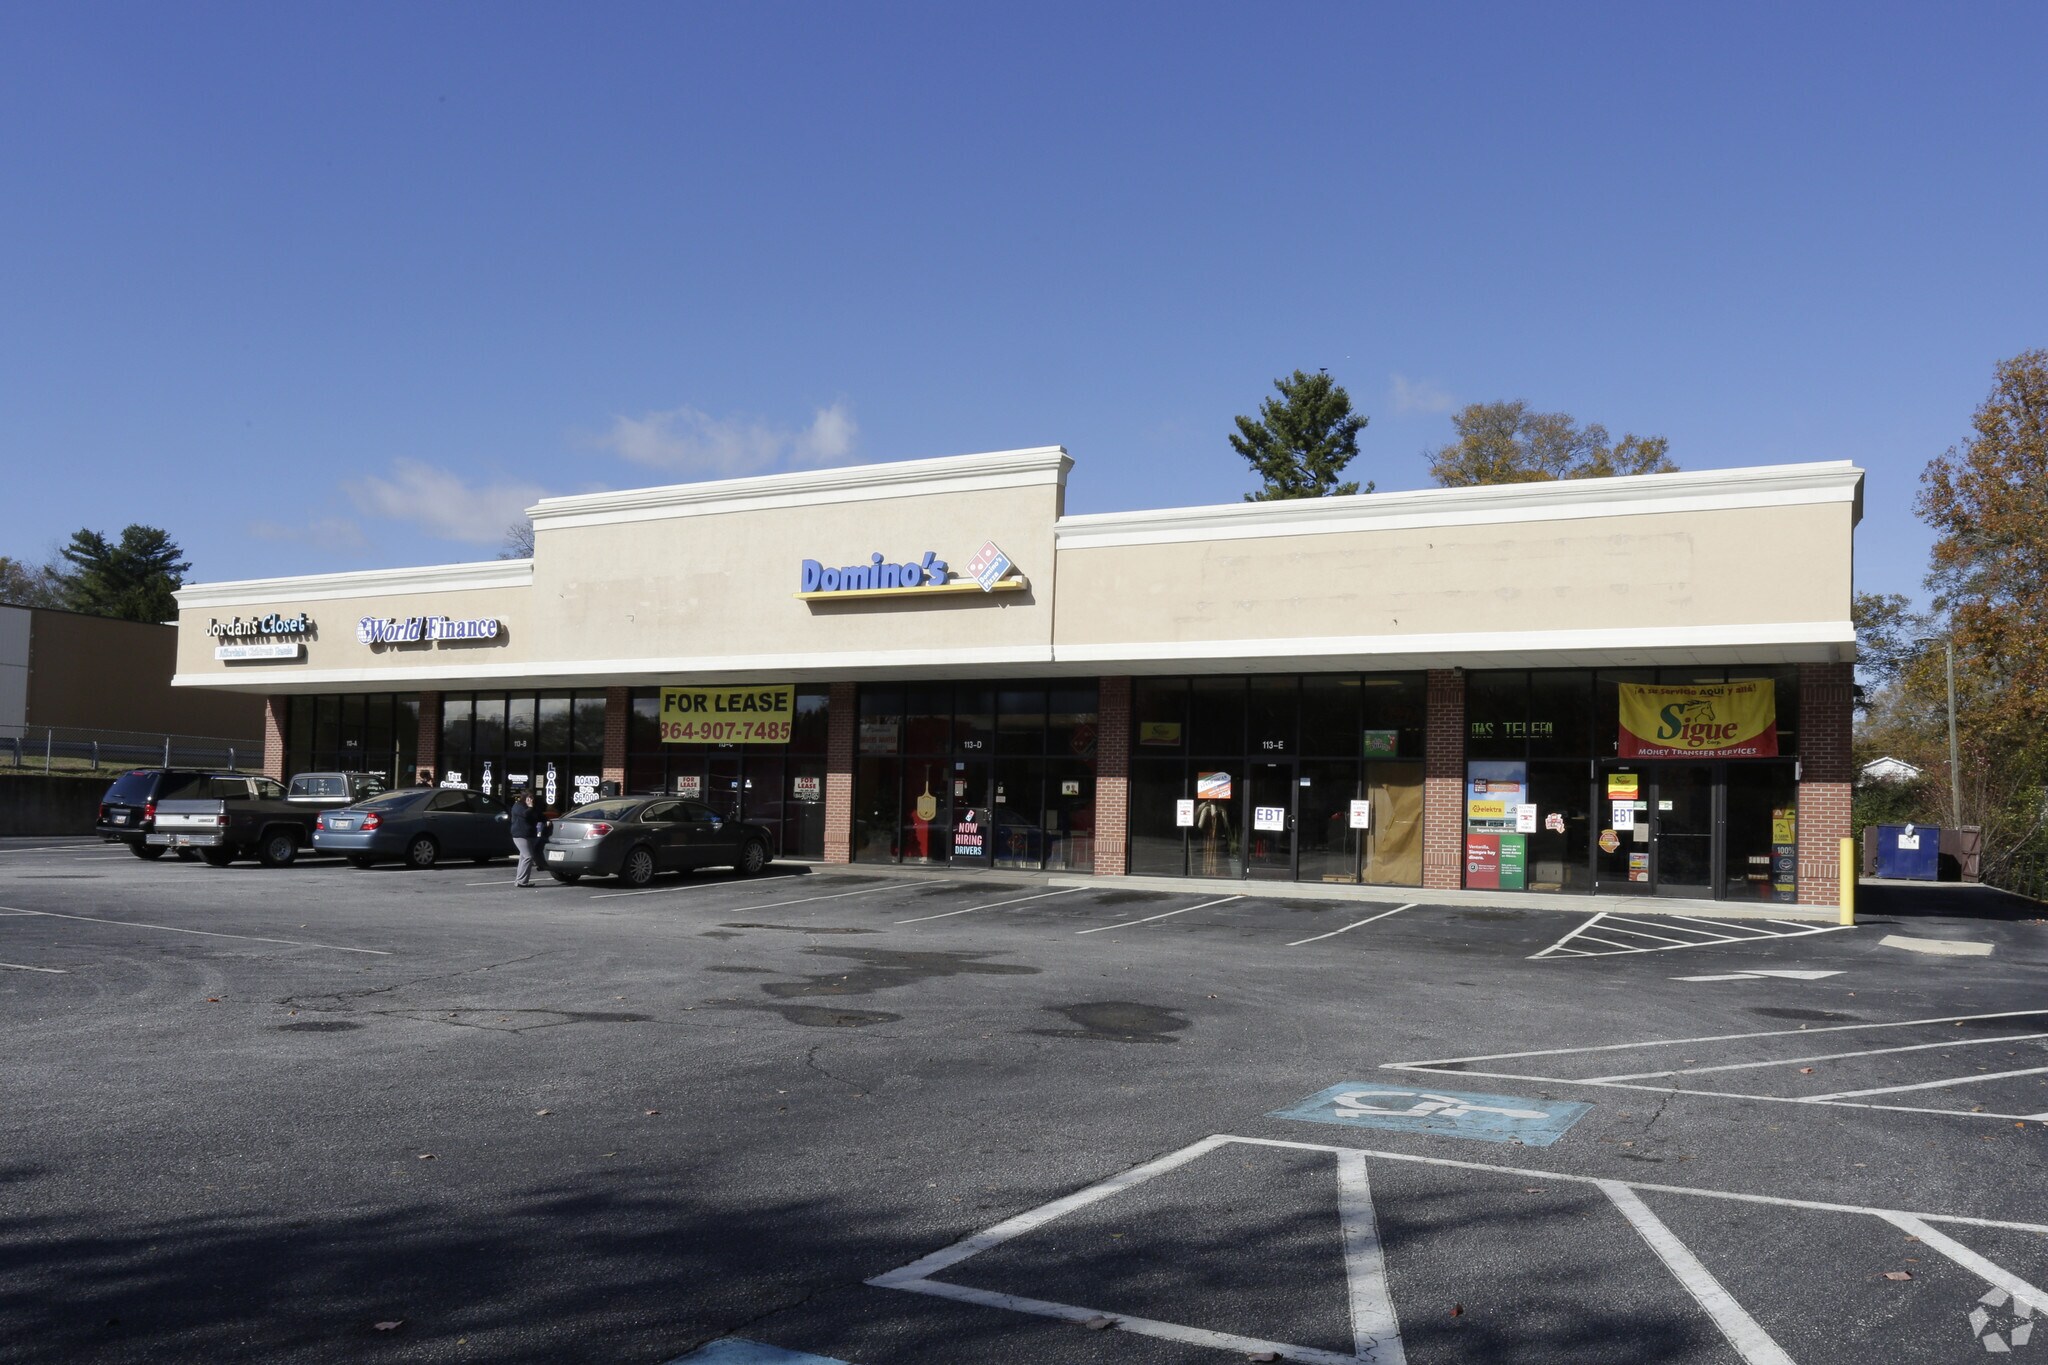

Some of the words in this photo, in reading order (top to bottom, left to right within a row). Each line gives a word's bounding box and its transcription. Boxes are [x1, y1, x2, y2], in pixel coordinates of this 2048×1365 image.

[801, 551, 949, 593] Domino's
[978, 556, 1003, 583] Domino's
[983, 571, 1000, 590] Pizza
[205, 616, 258, 637] Jordan's
[260, 612, 306, 634] Closet
[370, 616, 423, 642] World
[426, 615, 497, 639] Finance
[664, 693, 708, 713] FOR
[714, 691, 788, 713] LEASE
[661, 721, 791, 740] 864-907-7485
[1656, 702, 1739, 748] Sigue
[964, 740, 983, 749] 113-D
[1262, 740, 1284, 750] 113-E
[1638, 748, 1670, 757] MONEY
[1672, 748, 1715, 757] TRANSFER
[1717, 747, 1757, 757] SERVICES
[448, 772, 462, 781] Tax
[546, 761, 557, 804] LOANS
[574, 776, 600, 787] LOANS
[1256, 808, 1283, 822] EBT
[1613, 808, 1633, 823] EBT
[958, 822, 978, 834] NOW
[955, 834, 982, 846] HIRING
[955, 845, 982, 855] DRIVERS
[1777, 846, 1795, 856] 100%
